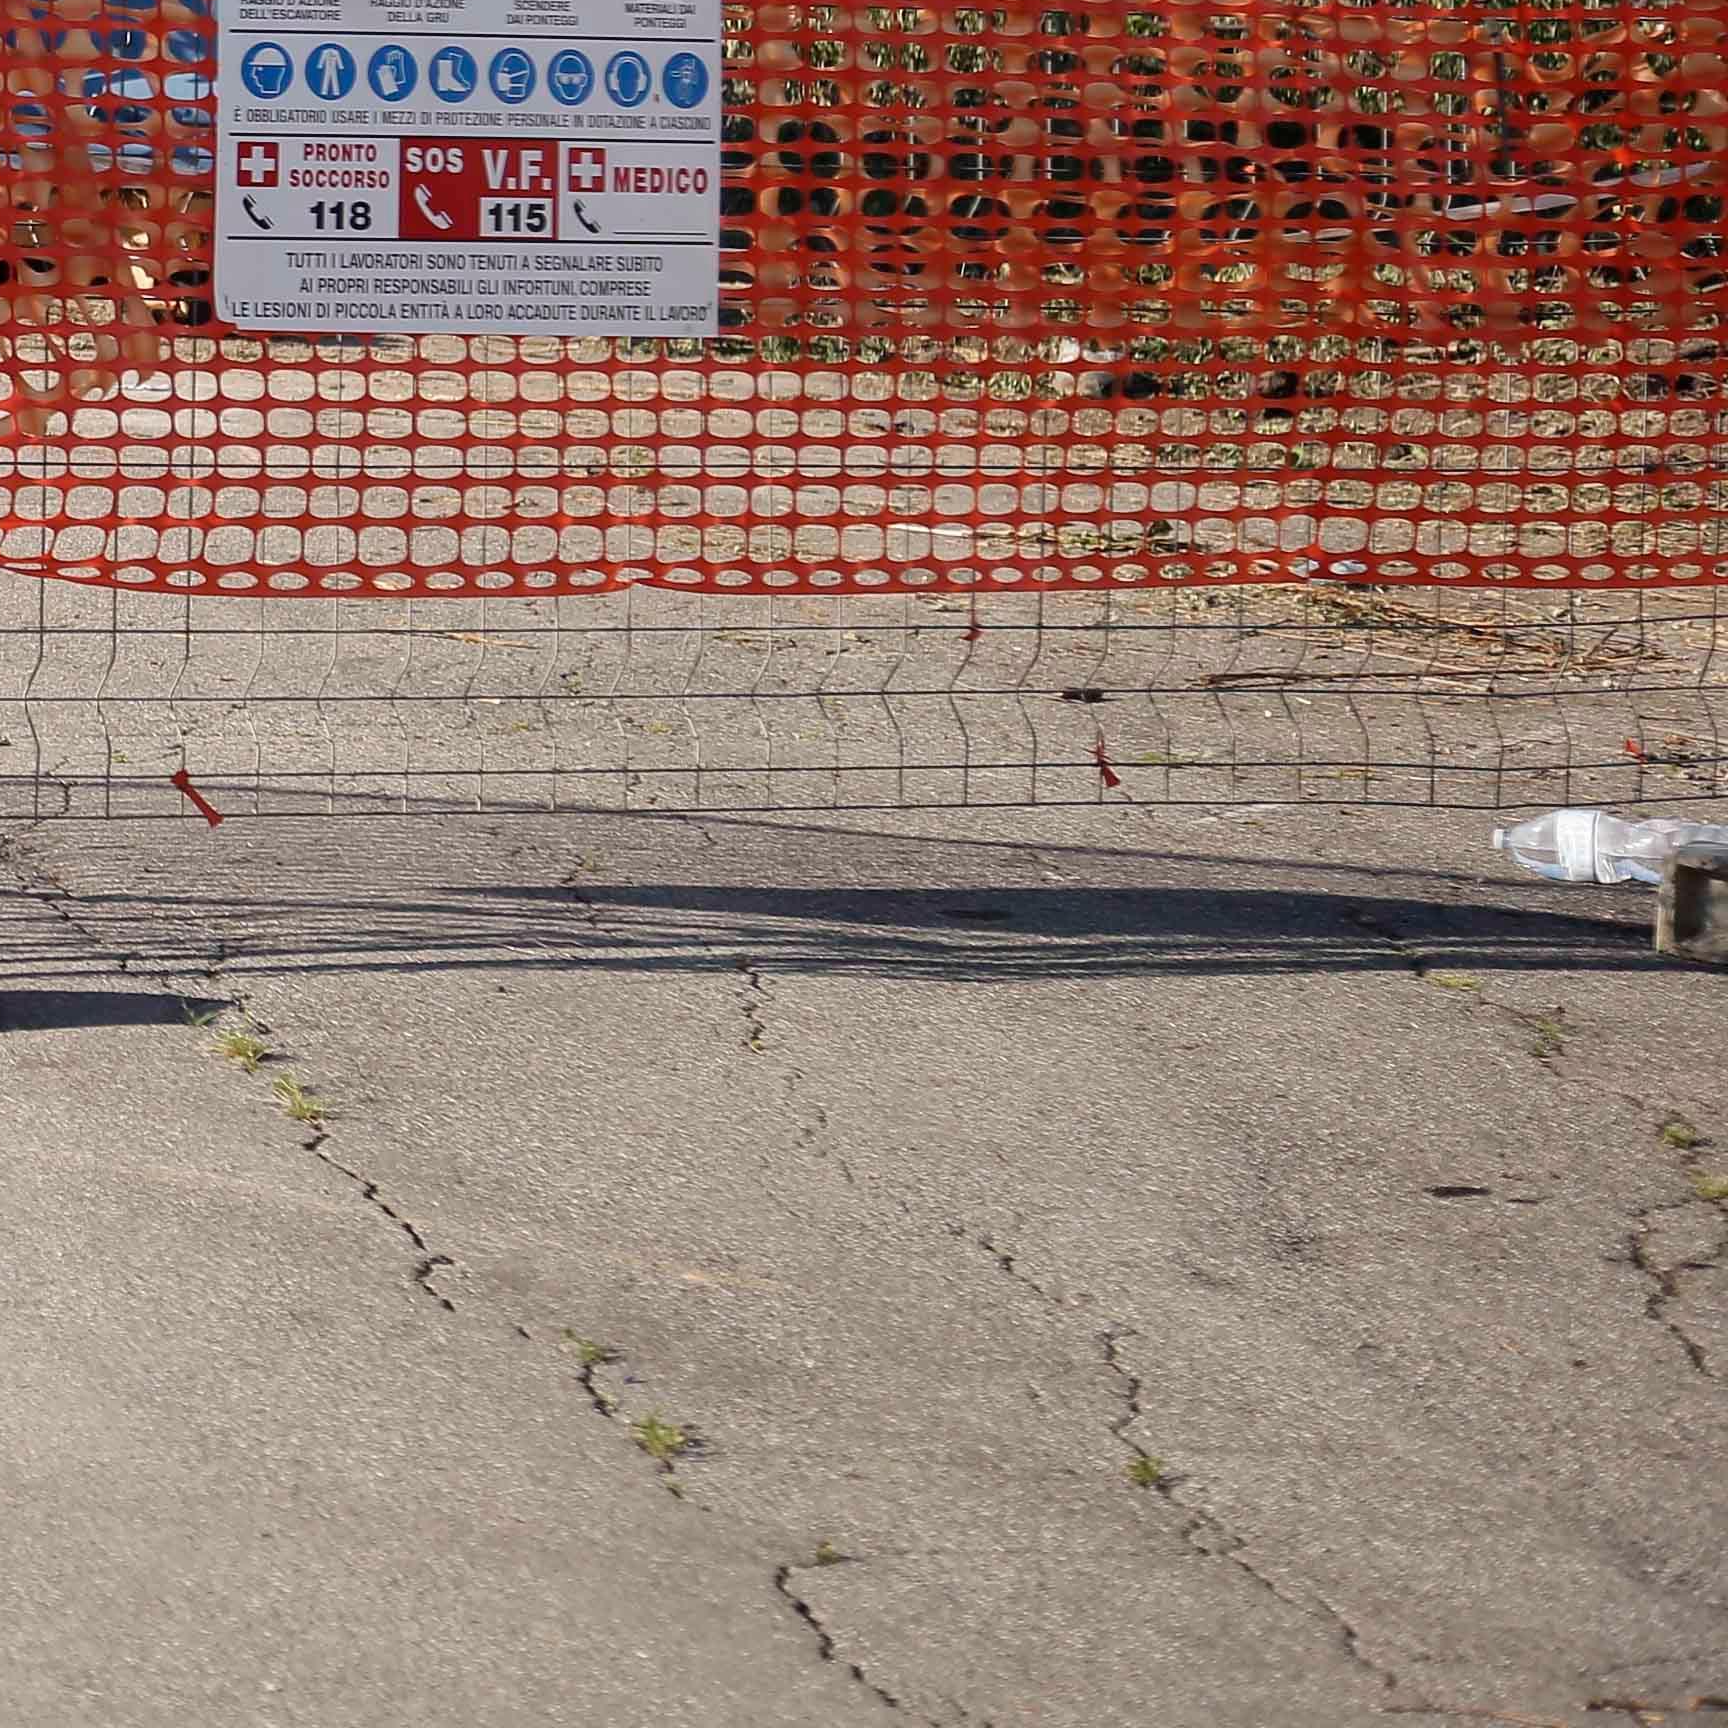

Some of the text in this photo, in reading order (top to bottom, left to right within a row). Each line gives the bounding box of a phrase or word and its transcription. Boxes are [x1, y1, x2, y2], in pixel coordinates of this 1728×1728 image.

[240, 9, 342, 20] DELL'ESCAVATORE
[514, 1, 571, 11] SCENDERE
[624, 3, 696, 14] MATERIALI DAI
[387, 12, 449, 23] DELLA GRU
[506, 14, 579, 25] DAI PONTEGGI
[634, 18, 687, 28] PONTEGGI
[246, 109, 326, 122] OBBLIGATORIO
[331, 111, 369, 123] USARE
[382, 111, 416, 124] MEZZI
[421, 112, 432, 125] DI
[436, 112, 503, 126] PROTEZIONE
[507, 113, 569, 127] PERSONALE
[572, 115, 584, 127] IN
[587, 115, 646, 128] DOTAZIONE
[659, 117, 711, 129] CIASCUNO
[303, 144, 377, 161] PRONTO
[406, 148, 464, 174] SOS
[289, 170, 390, 188] SOCCORSO
[482, 149, 552, 191] V.F.
[613, 168, 708, 193] MEDICO
[309, 202, 372, 230] 118
[489, 203, 547, 232] 115
[286, 253, 663, 271] TUTTI I LAVORATORI SONO TENUTI A SEGNALARE SUBITO
[299, 278, 313, 293] AI
[317, 278, 369, 293] PROPRI
[373, 279, 472, 294] RESPONSABILI
[476, 280, 498, 295] GLI
[579, 281, 651, 296] COMPRESE
[231, 302, 250, 317] LE
[254, 302, 312, 317] LESIONI
[315, 303, 330, 318] DI
[334, 303, 397, 318] PICCOLA
[454, 304, 463, 319] A
[467, 304, 503, 319] LORO
[507, 305, 577, 320] ACCADUTE
[580, 305, 641, 320] DURANTE
[645, 306, 656, 320] IL
[660, 306, 707, 321] LAVORO
